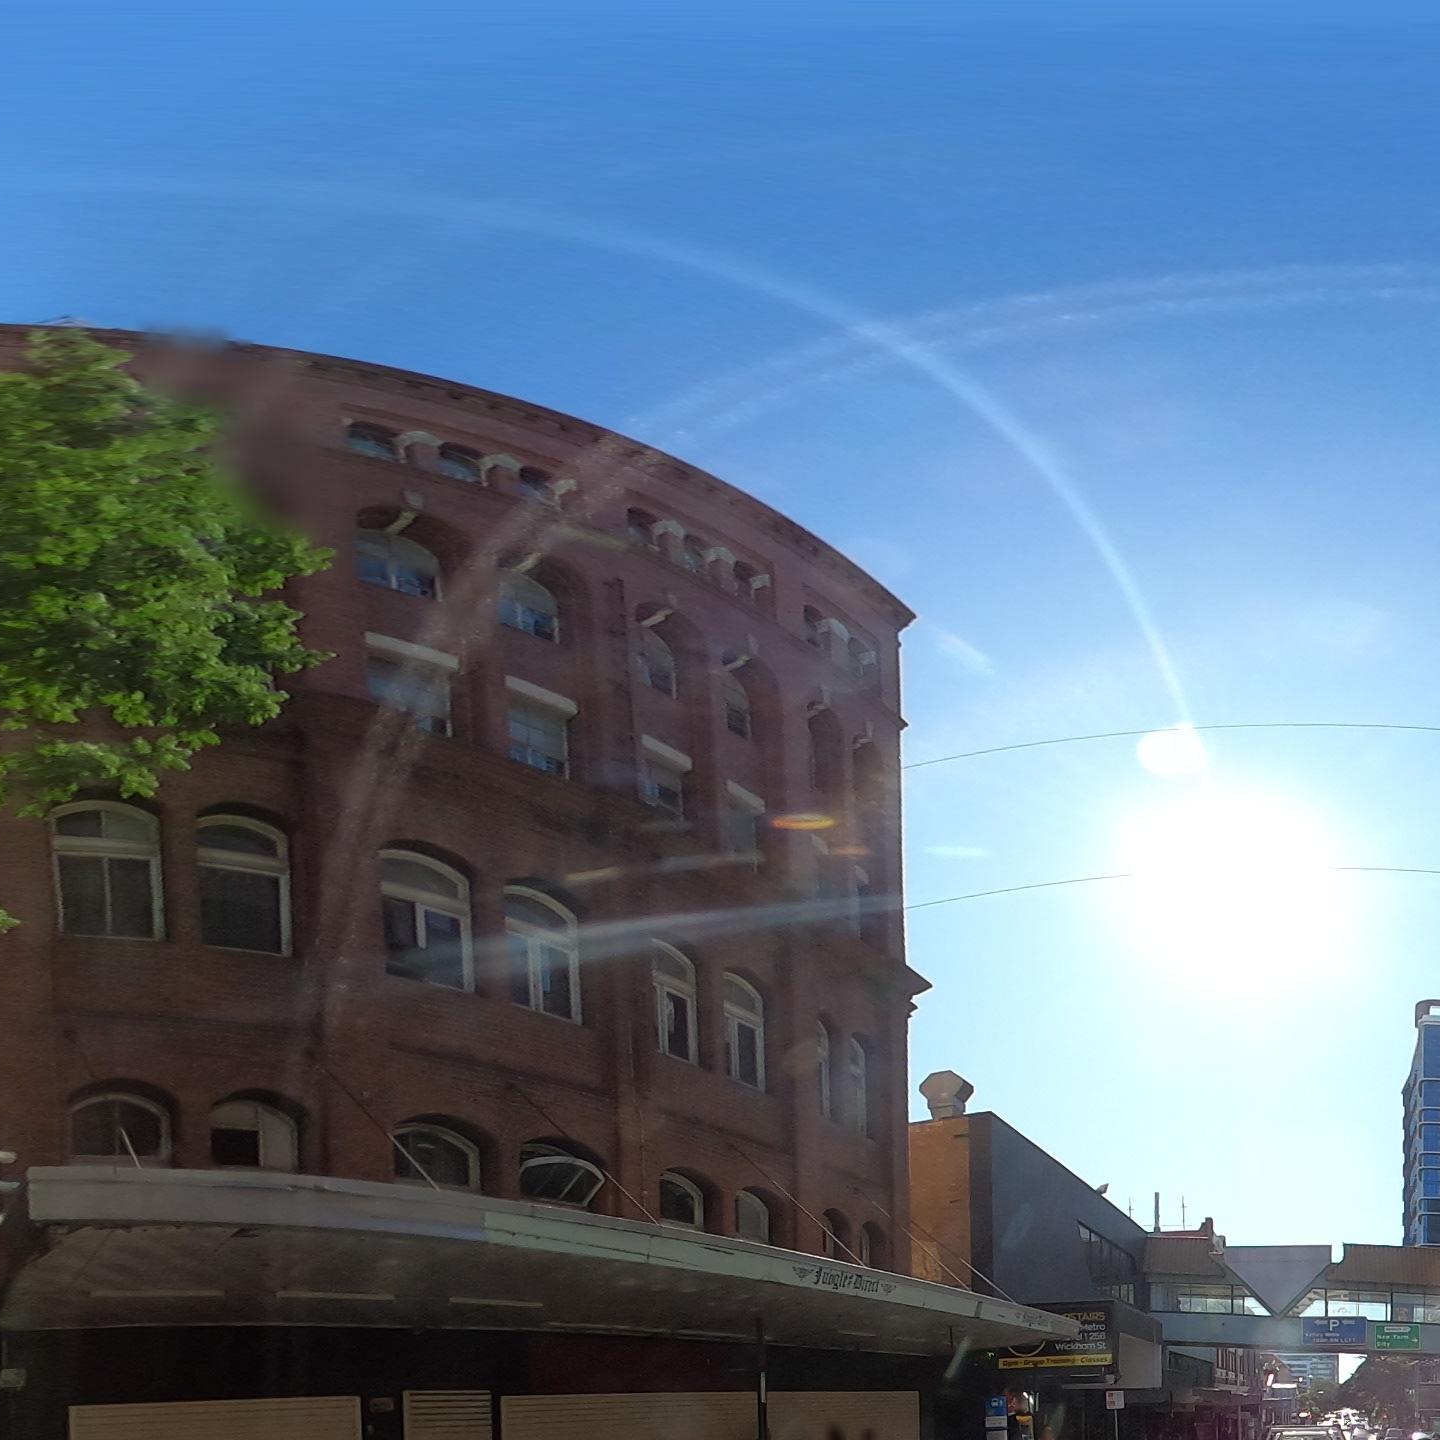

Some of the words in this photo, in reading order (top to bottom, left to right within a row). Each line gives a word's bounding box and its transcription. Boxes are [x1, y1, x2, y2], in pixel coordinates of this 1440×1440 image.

[1064, 1312, 1106, 1321] PSTAIRS
[1329, 1319, 1340, 1331] P
[1096, 1341, 1107, 1350] St
